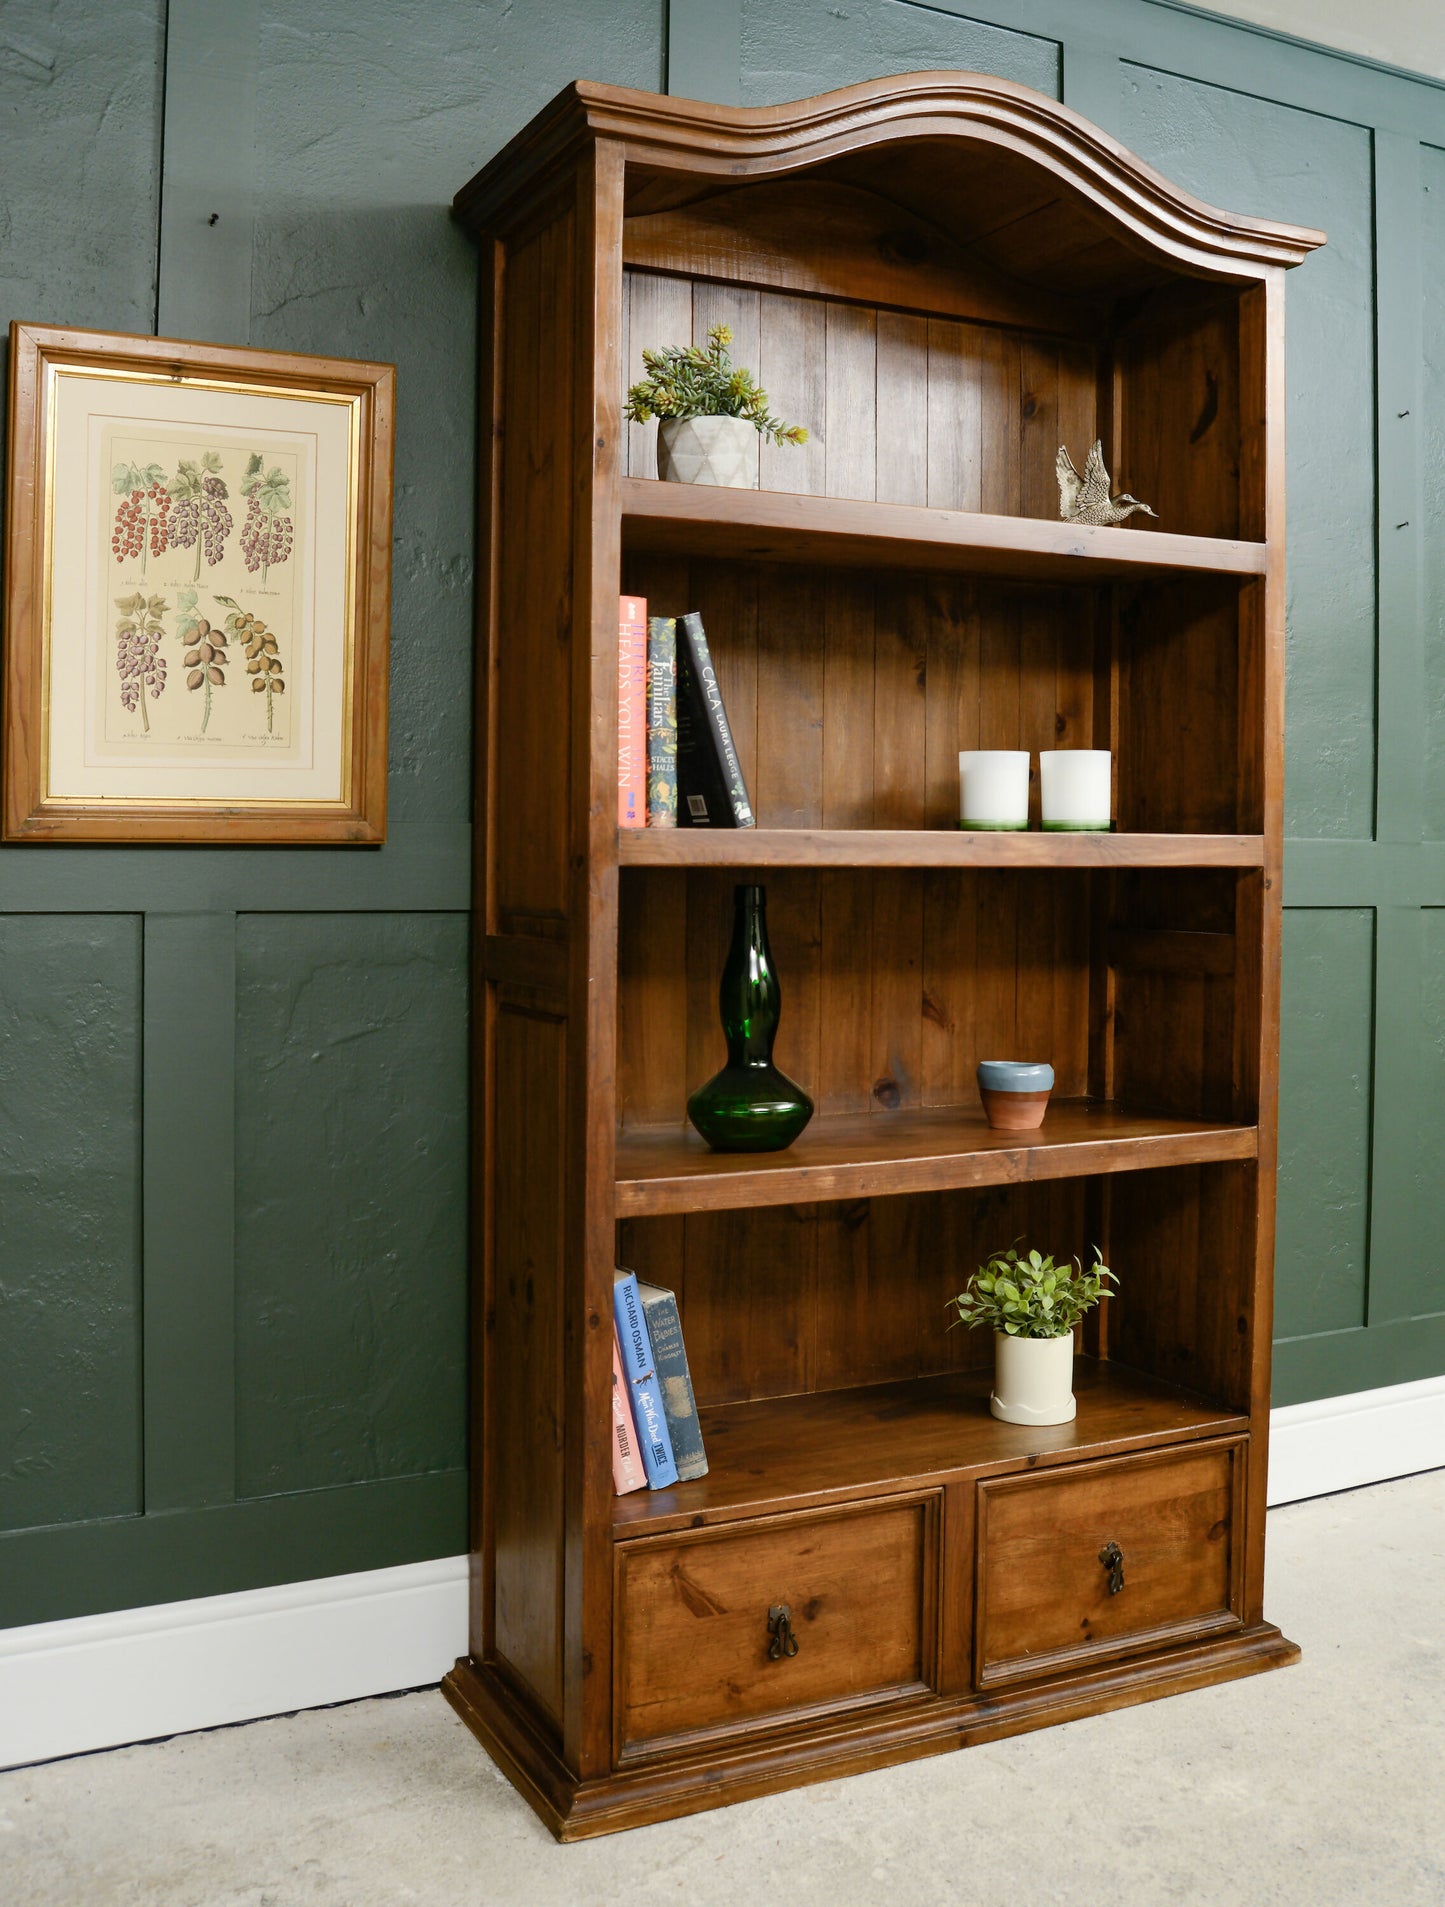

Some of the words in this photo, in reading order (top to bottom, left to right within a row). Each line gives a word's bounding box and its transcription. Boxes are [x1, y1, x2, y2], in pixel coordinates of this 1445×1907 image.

[618, 623, 632, 690] HEADS
[702, 666, 722, 711] CALA
[618, 697, 632, 739] YOU
[651, 755, 675, 764] STACEY
[715, 713, 730, 747] LAURA
[724, 748, 739, 779] LEGGE
[618, 745, 632, 788] WIN
[652, 763, 675, 772] HALLS
[653, 1315, 676, 1329] WATER
[632, 1329, 647, 1369] OSMAN
[638, 1392, 650, 1410] Man
[644, 1408, 659, 1426] Who
[616, 1423, 631, 1458] MURDER
[648, 1424, 662, 1444] Died
[653, 1442, 668, 1466] TWICE
